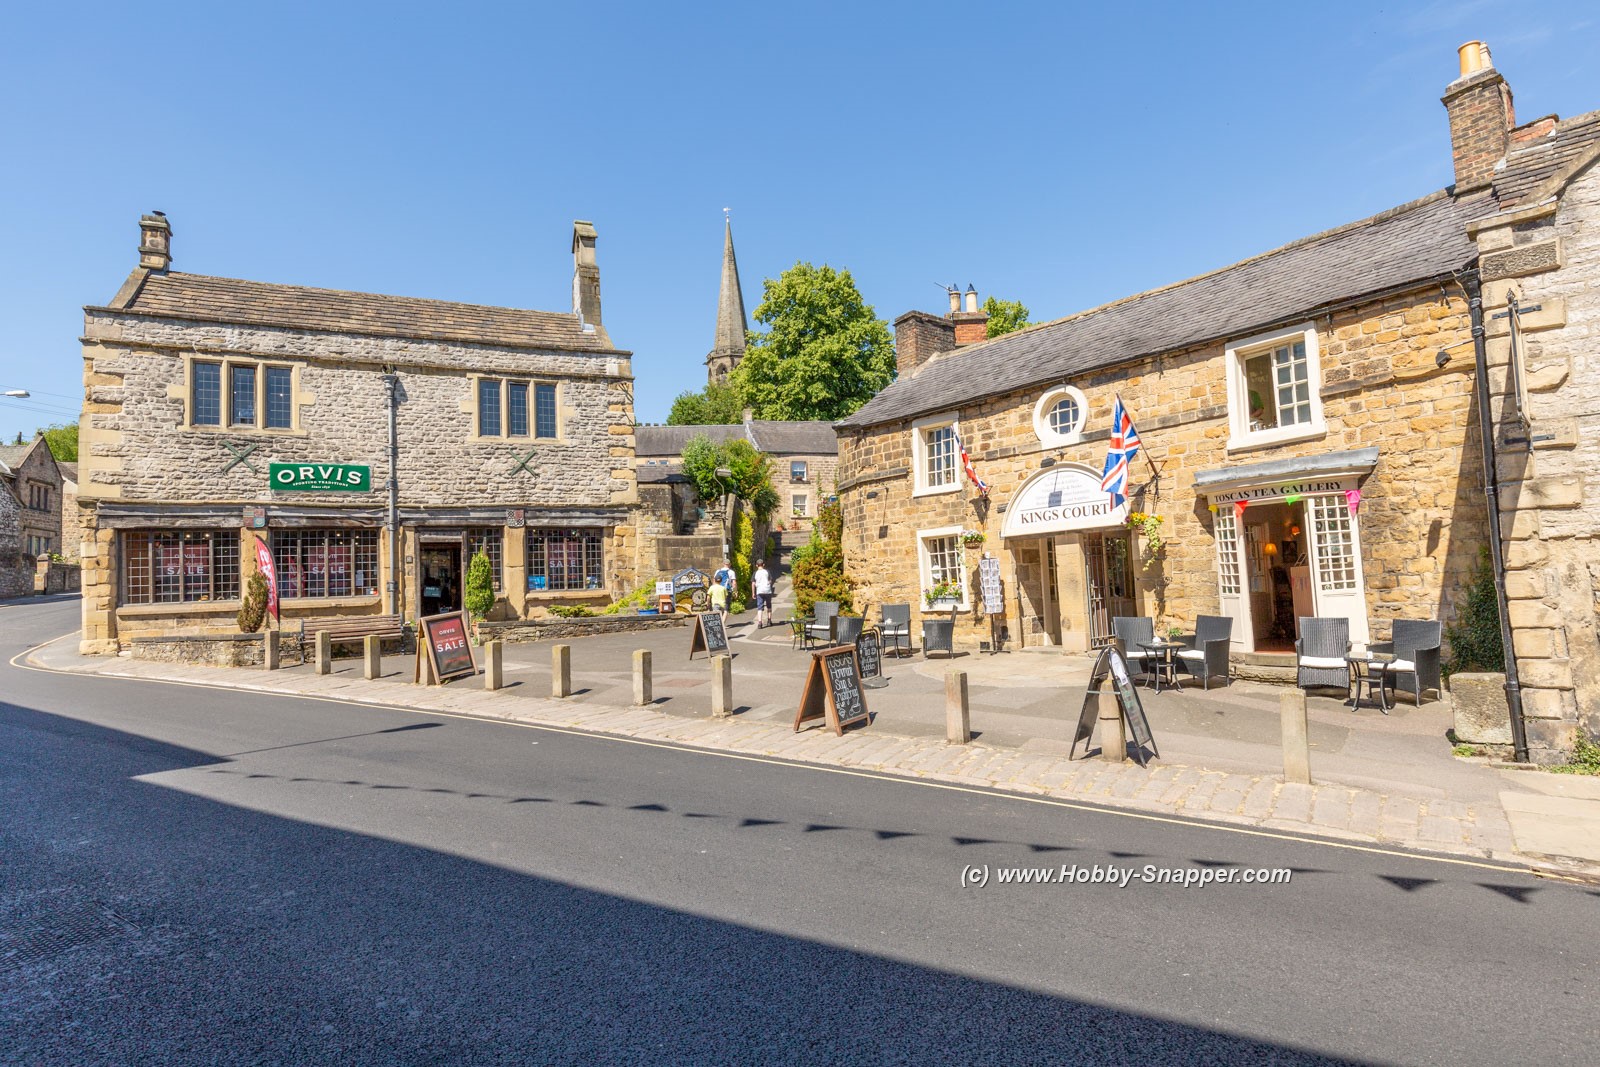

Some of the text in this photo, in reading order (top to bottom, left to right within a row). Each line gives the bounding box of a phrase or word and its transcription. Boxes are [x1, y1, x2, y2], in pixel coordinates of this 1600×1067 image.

[277, 466, 362, 485] ORVIS
[1214, 481, 1343, 503] TOSCAS TEA GALLERY
[1021, 503, 1110, 524] KINGS COURT
[167, 565, 204, 575] SALE
[437, 640, 465, 653] SALE
